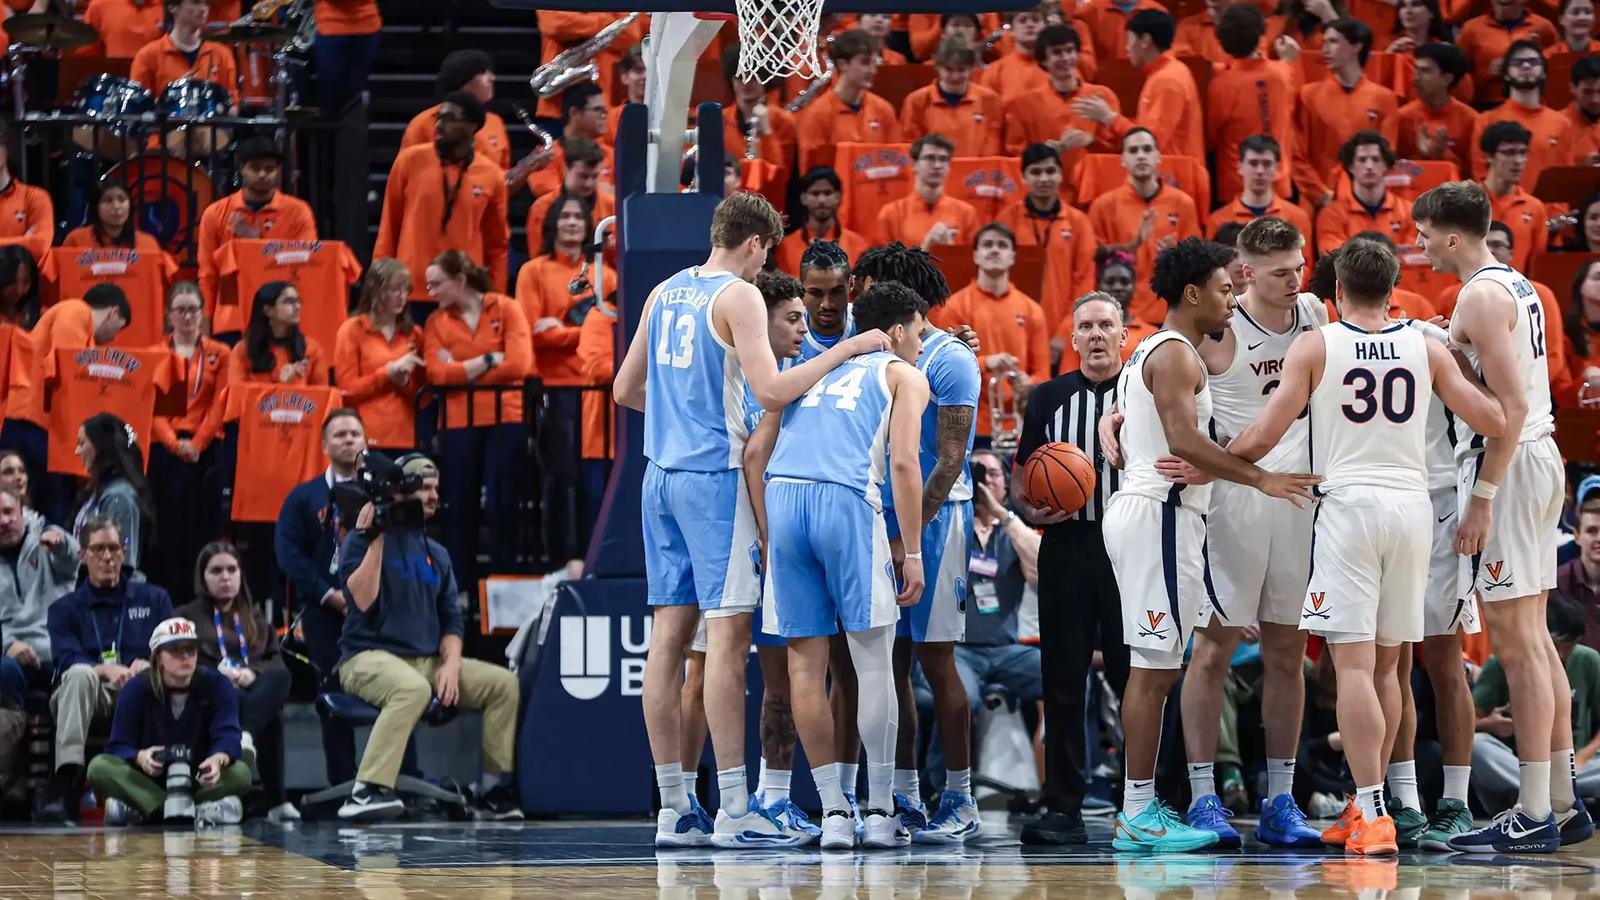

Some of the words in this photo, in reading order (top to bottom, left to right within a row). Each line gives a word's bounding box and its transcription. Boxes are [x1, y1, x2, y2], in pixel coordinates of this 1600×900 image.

[656, 309, 696, 369] 13
[1355, 342, 1400, 360] HALL
[1341, 367, 1416, 424] 30
